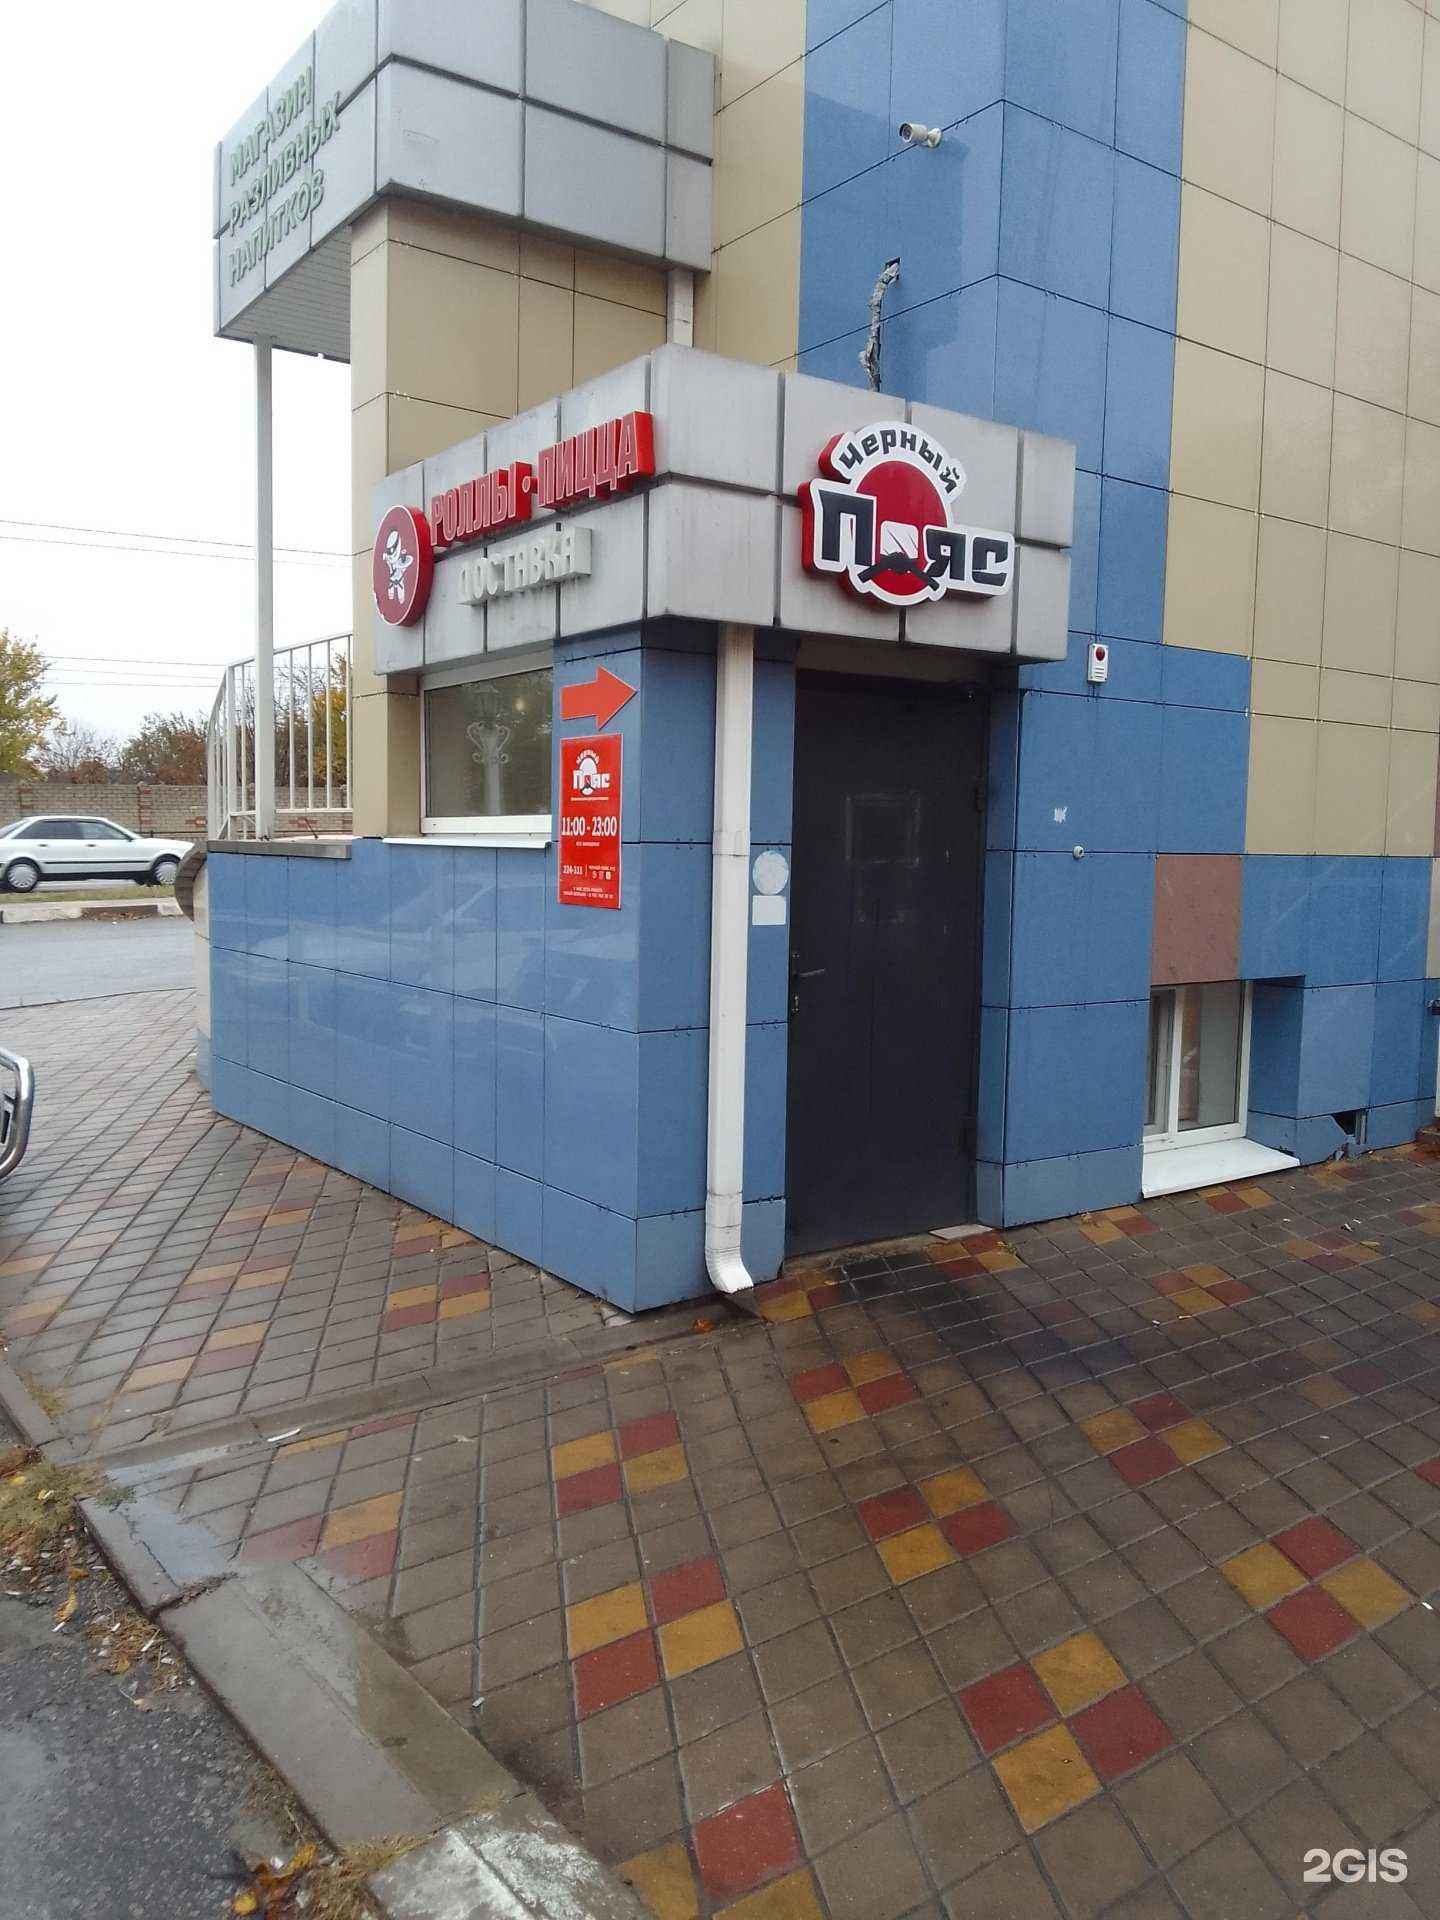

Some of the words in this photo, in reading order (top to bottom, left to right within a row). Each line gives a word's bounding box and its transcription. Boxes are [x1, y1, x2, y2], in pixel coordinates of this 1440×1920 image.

[229, 91, 341, 237] РАЗЛИВНЫХ
[231, 66, 312, 186] МАГАЗИН
[229, 168, 324, 287] НАПИТКОВ
[431, 461, 530, 547] РОЛЛЫ
[538, 410, 653, 509] ПИЦЦА
[458, 526, 592, 605] ДОСТАВКА
[561, 816, 585, 836] 11:00
[591, 816, 618, 837] 23:00
